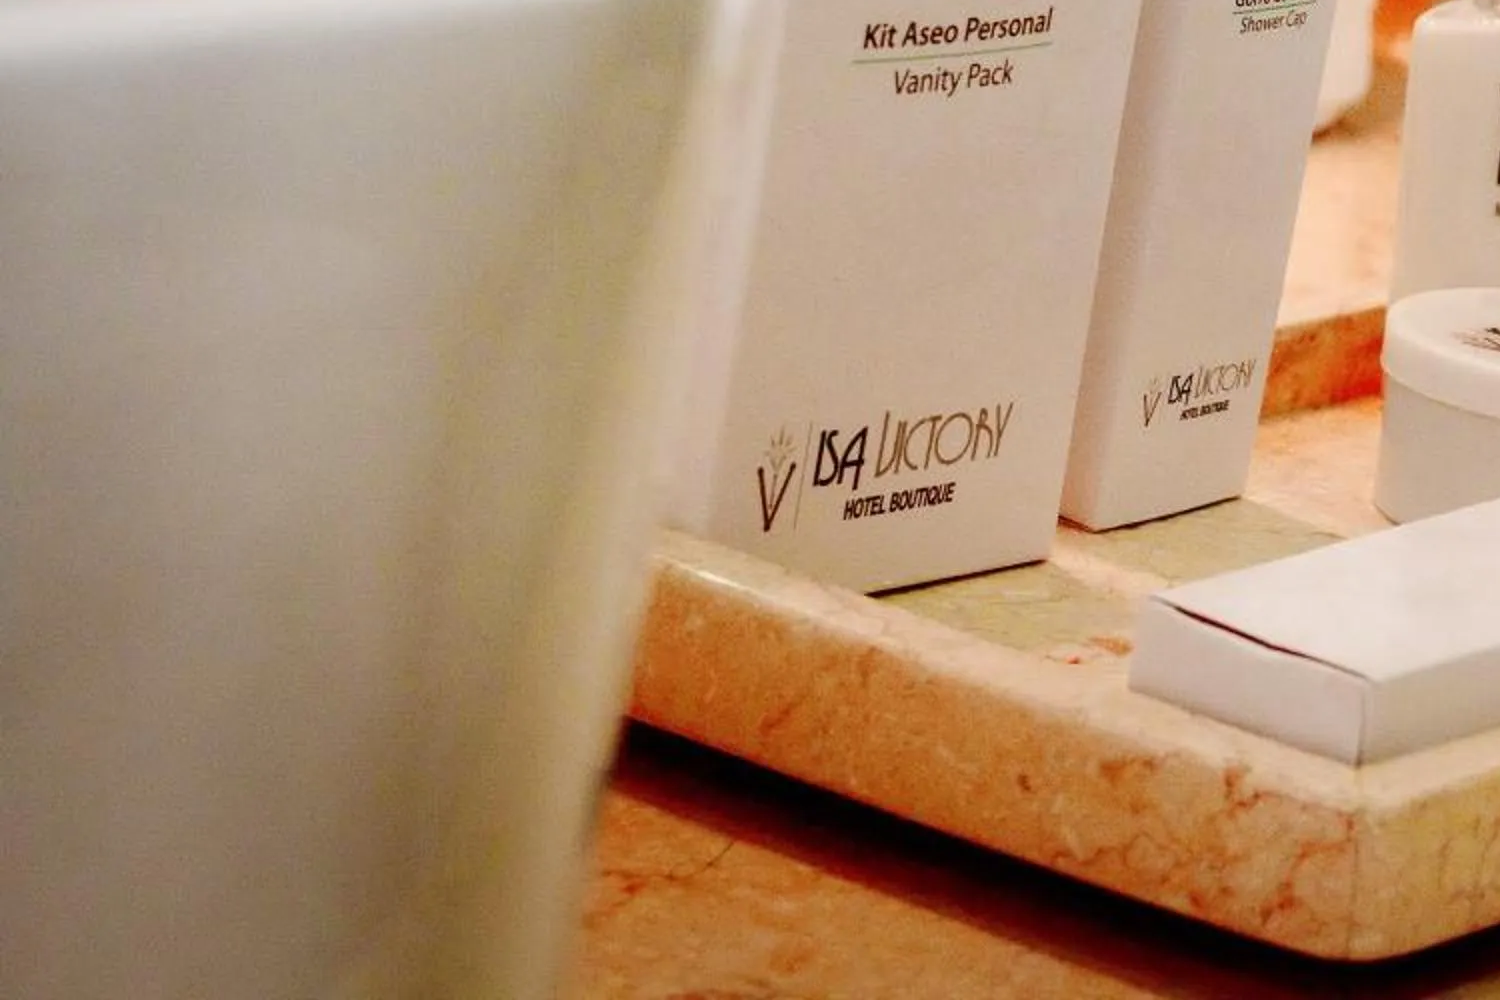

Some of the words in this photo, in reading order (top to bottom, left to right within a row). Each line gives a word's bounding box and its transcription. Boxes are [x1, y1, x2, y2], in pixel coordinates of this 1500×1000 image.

[863, 22, 898, 50] Kit
[902, 21, 959, 47] Aseo
[964, 5, 1054, 42] Personal
[1240, 15, 1285, 34] Shower
[1286, 10, 1307, 30] Cap
[894, 66, 963, 99] Vanity
[967, 58, 1014, 88] Pack
[811, 425, 869, 490] ISA
[843, 494, 885, 521] HOTEL
[888, 482, 956, 513] BOUTIQUE
